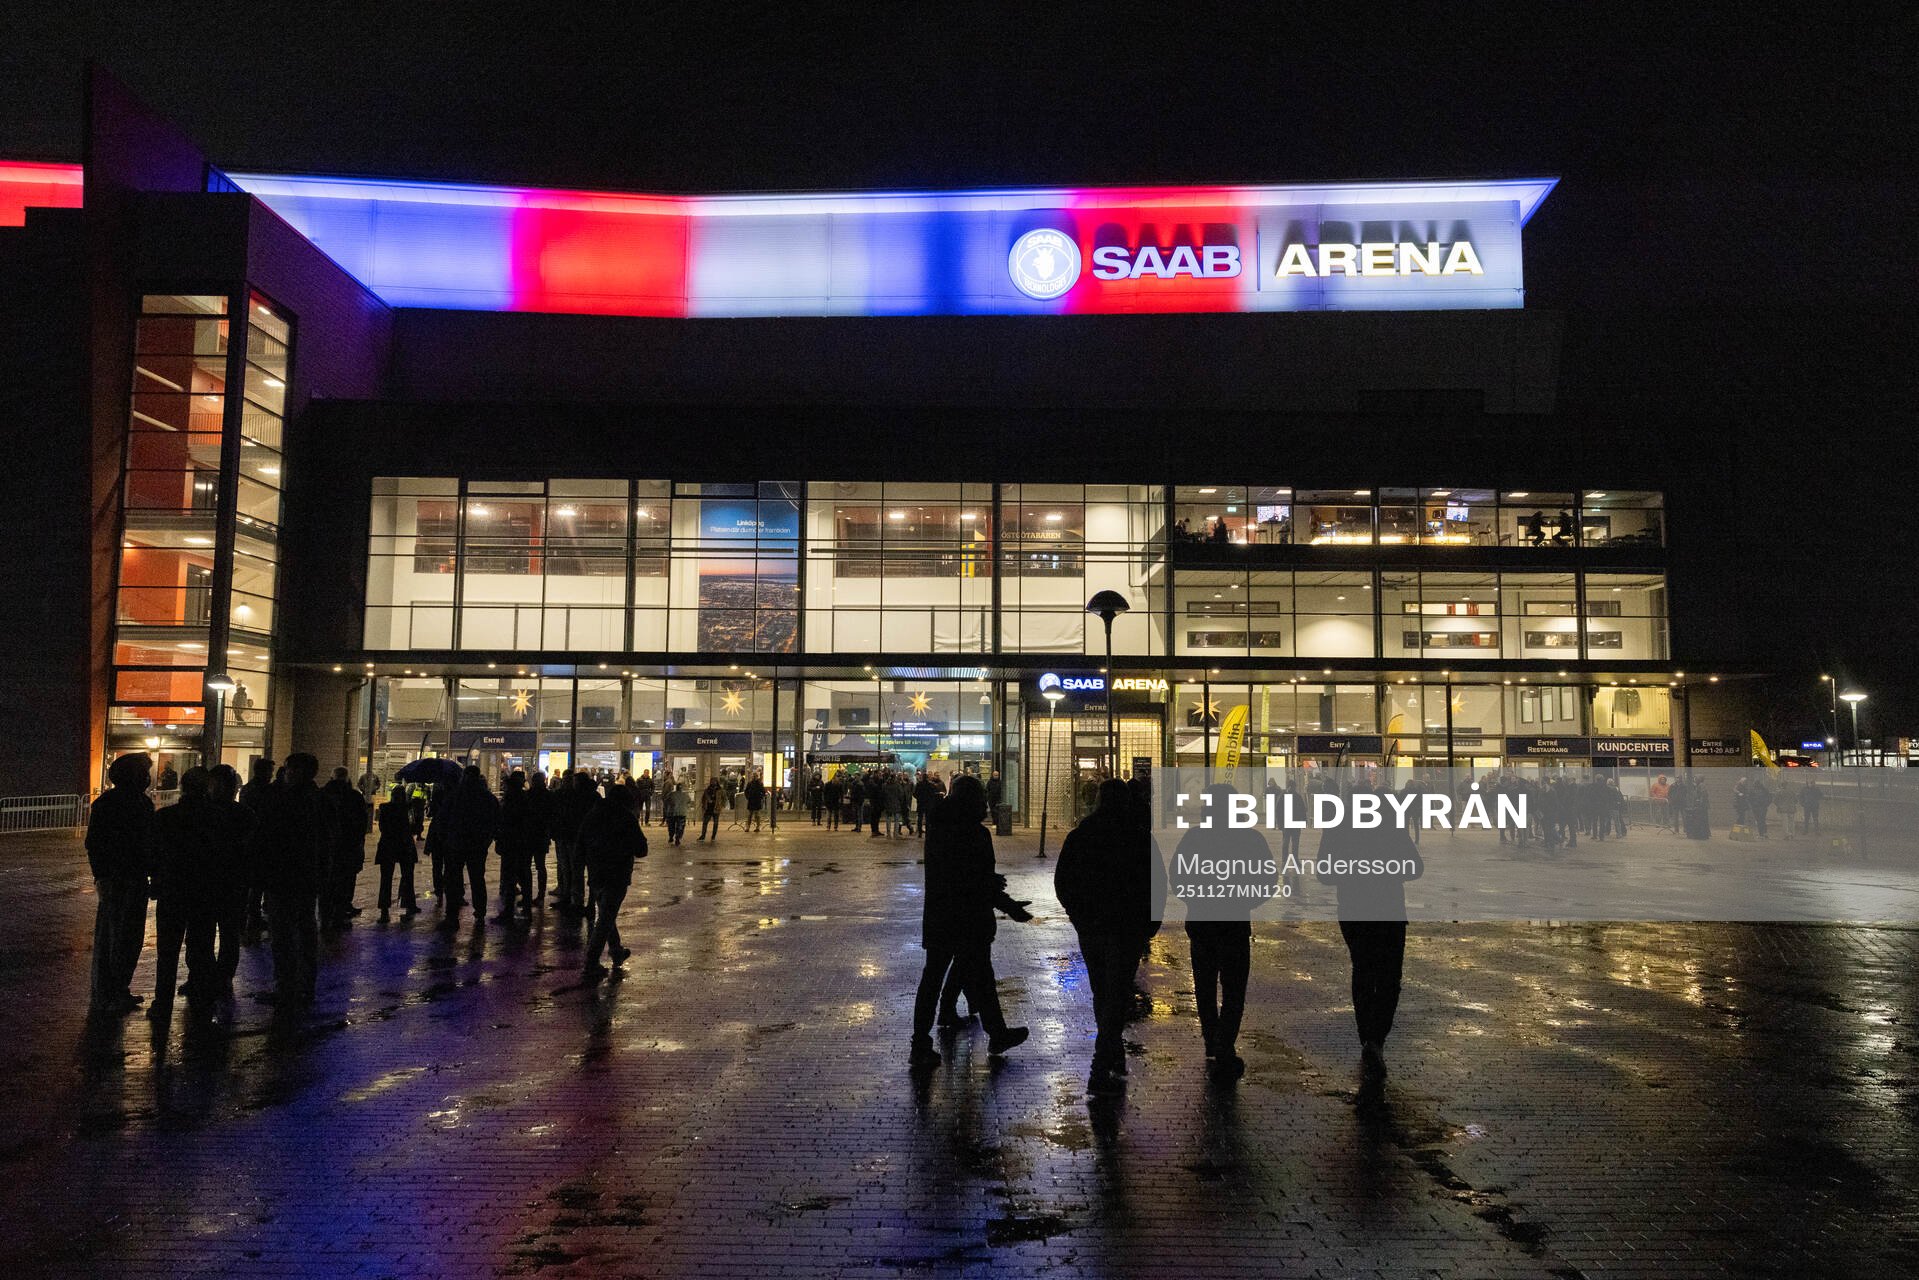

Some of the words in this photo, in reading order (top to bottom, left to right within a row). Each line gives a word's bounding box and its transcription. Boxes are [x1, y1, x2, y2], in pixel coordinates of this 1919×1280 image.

[1092, 245, 1242, 280] SAAB
[1275, 241, 1484, 278] ARENA
[736, 520, 765, 528] Linköpng
[1062, 678, 1105, 690] SAAB
[1111, 678, 1170, 690] ARENA
[1597, 742, 1669, 752] KUNDCENTER
[1223, 722, 1241, 785] ssemblin
